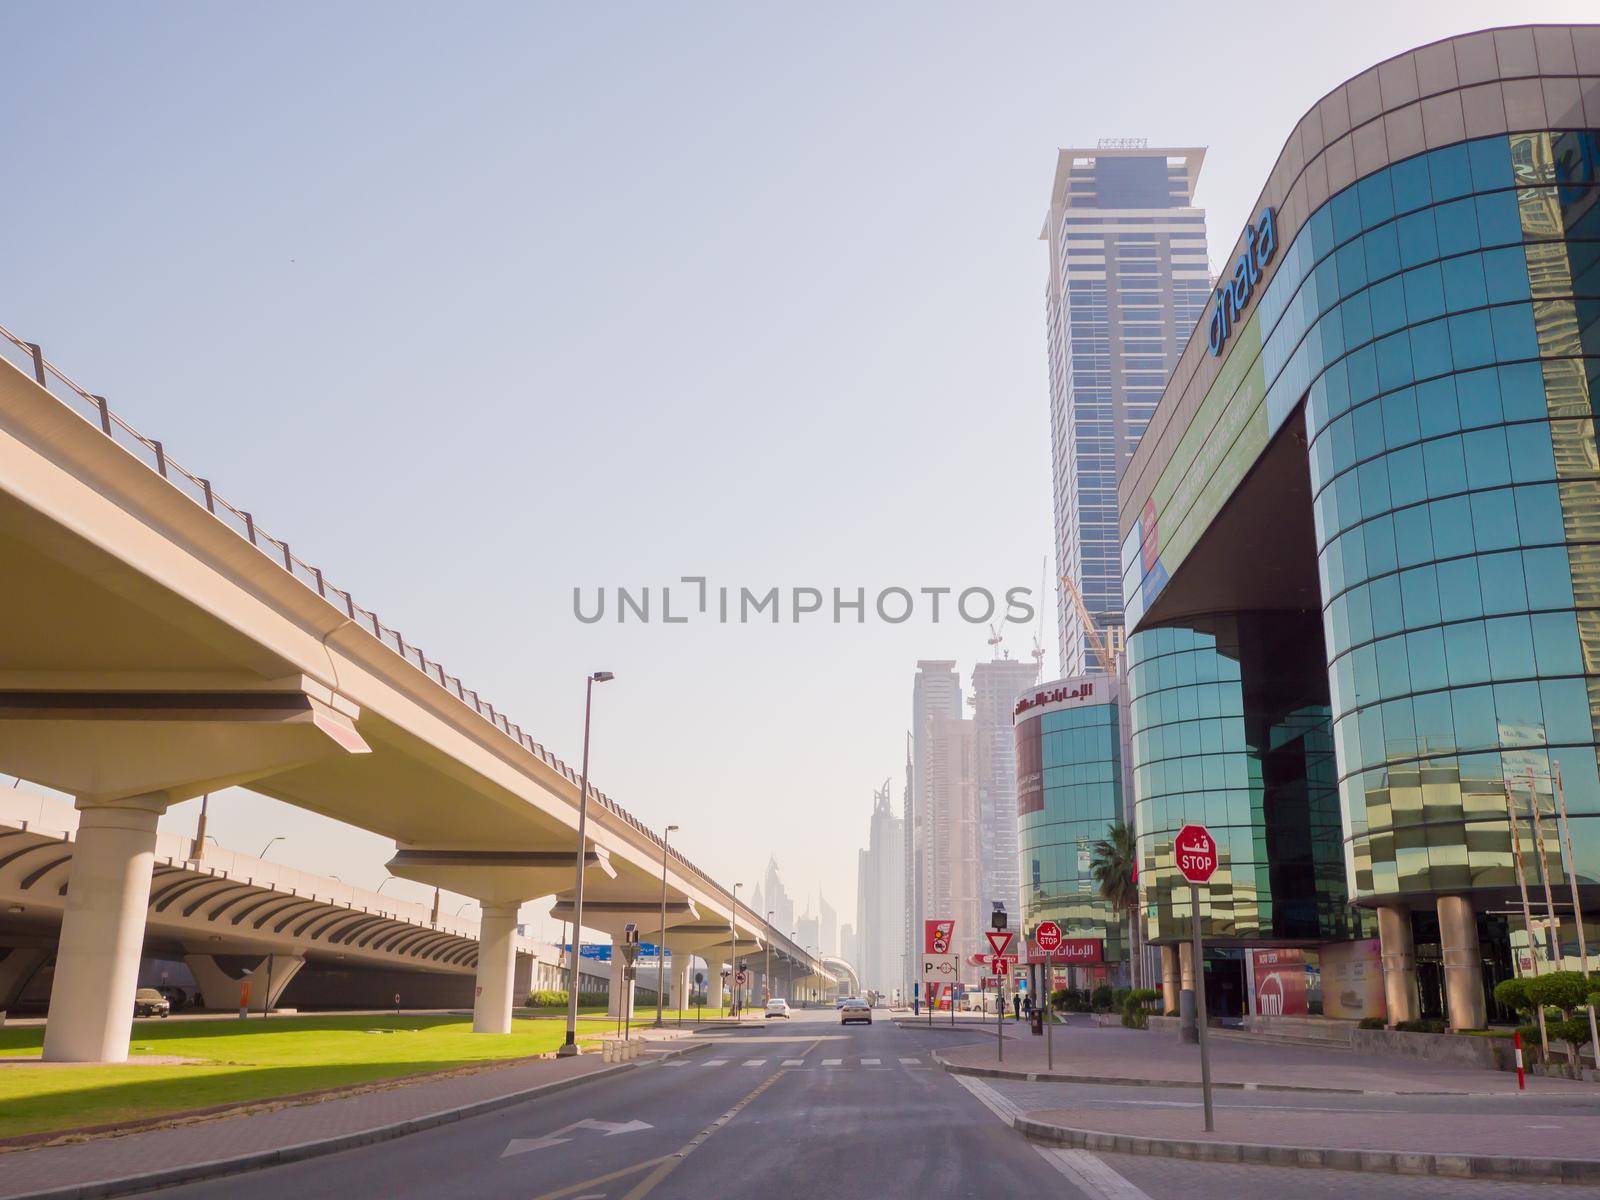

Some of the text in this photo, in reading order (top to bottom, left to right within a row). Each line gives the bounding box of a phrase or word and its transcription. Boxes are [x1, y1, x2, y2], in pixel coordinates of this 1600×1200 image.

[1209, 207, 1277, 357] dnata
[1182, 835, 1209, 853] قف
[1182, 855, 1211, 870] STOP
[1040, 927, 1056, 936] قف
[1040, 937, 1057, 945] STOP
[1057, 945, 1094, 958] الإمارات
[925, 962, 934, 974] P
